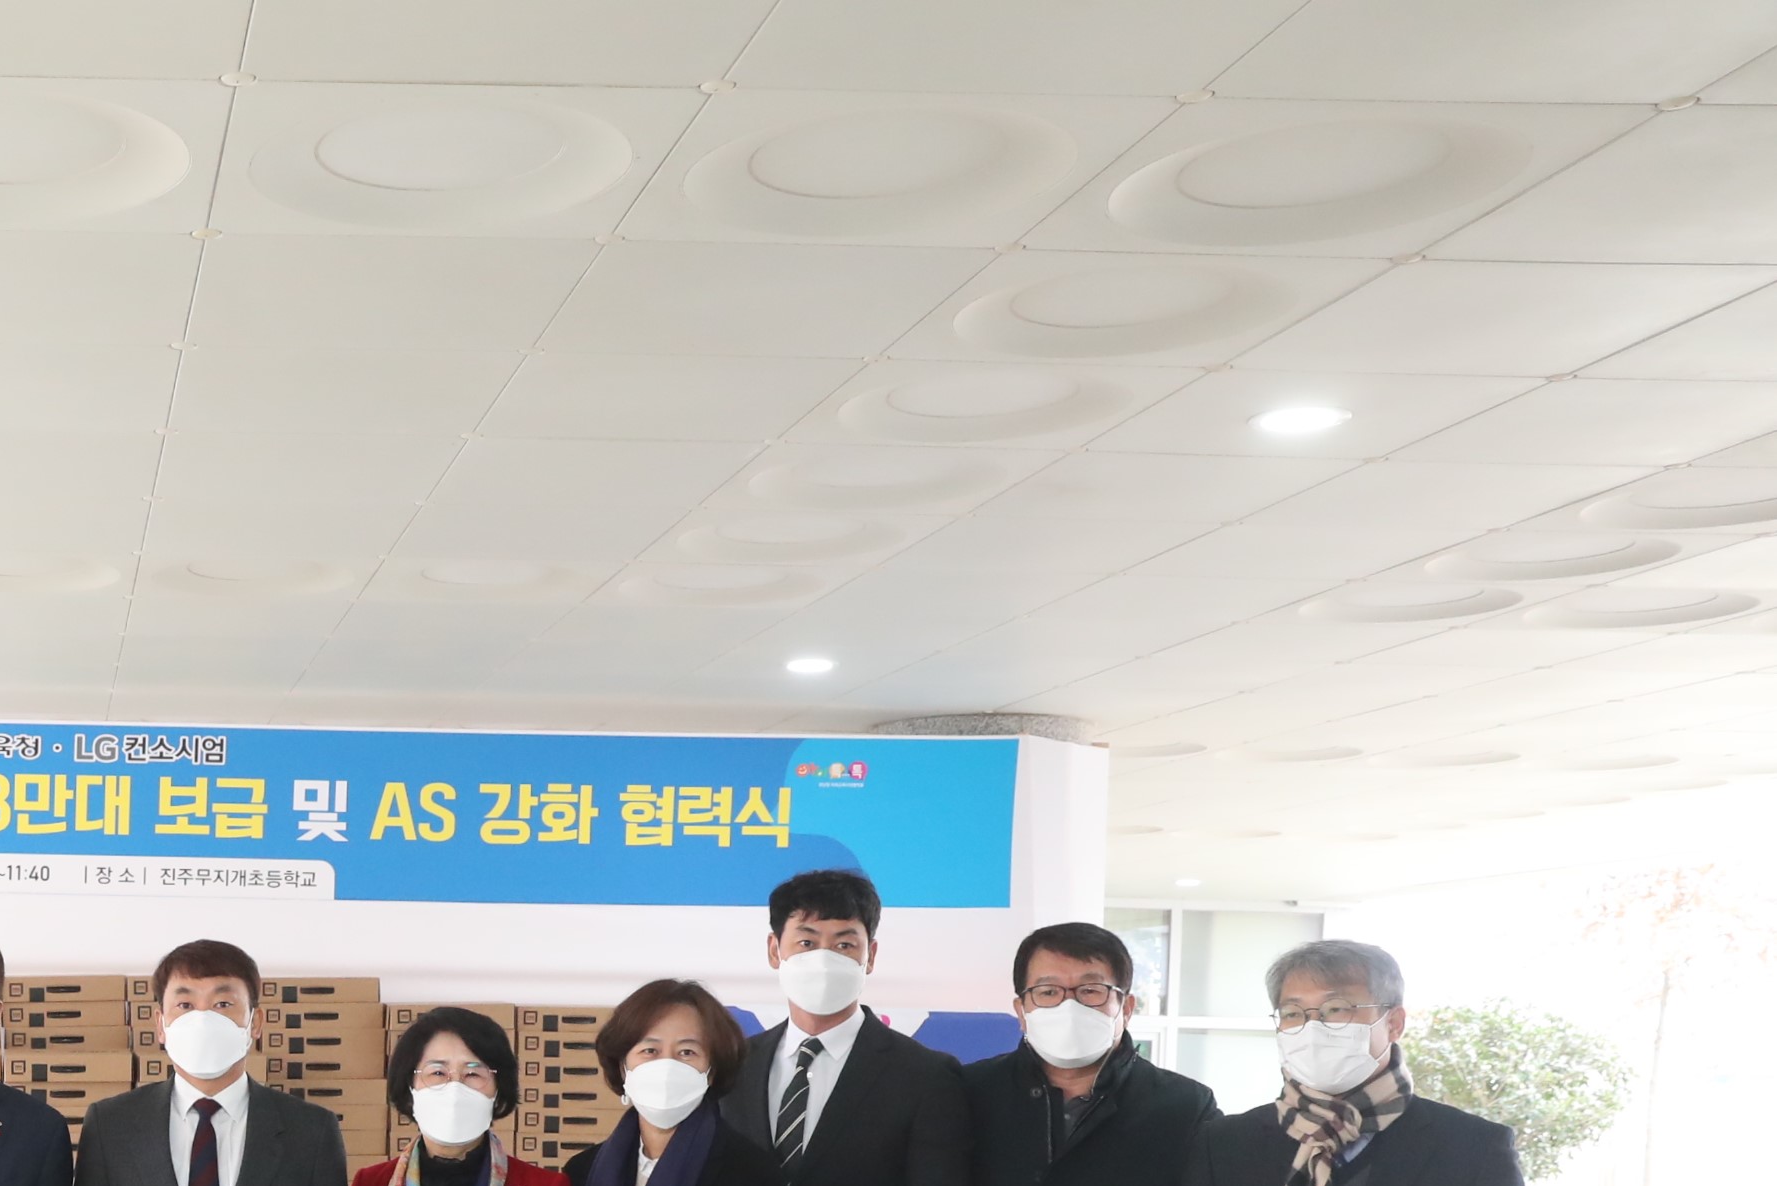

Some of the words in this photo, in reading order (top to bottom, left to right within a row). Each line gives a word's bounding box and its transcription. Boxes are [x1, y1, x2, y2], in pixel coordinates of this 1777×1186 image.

[75, 734, 118, 762] LG
[122, 735, 228, 765] 컨소시엄
[154, 776, 269, 839] 보급
[292, 779, 349, 842] 및
[369, 781, 458, 843] AS
[478, 783, 599, 845] 강화
[619, 784, 792, 848] 협력식
[159, 866, 318, 888] 진주무지개초등학교
